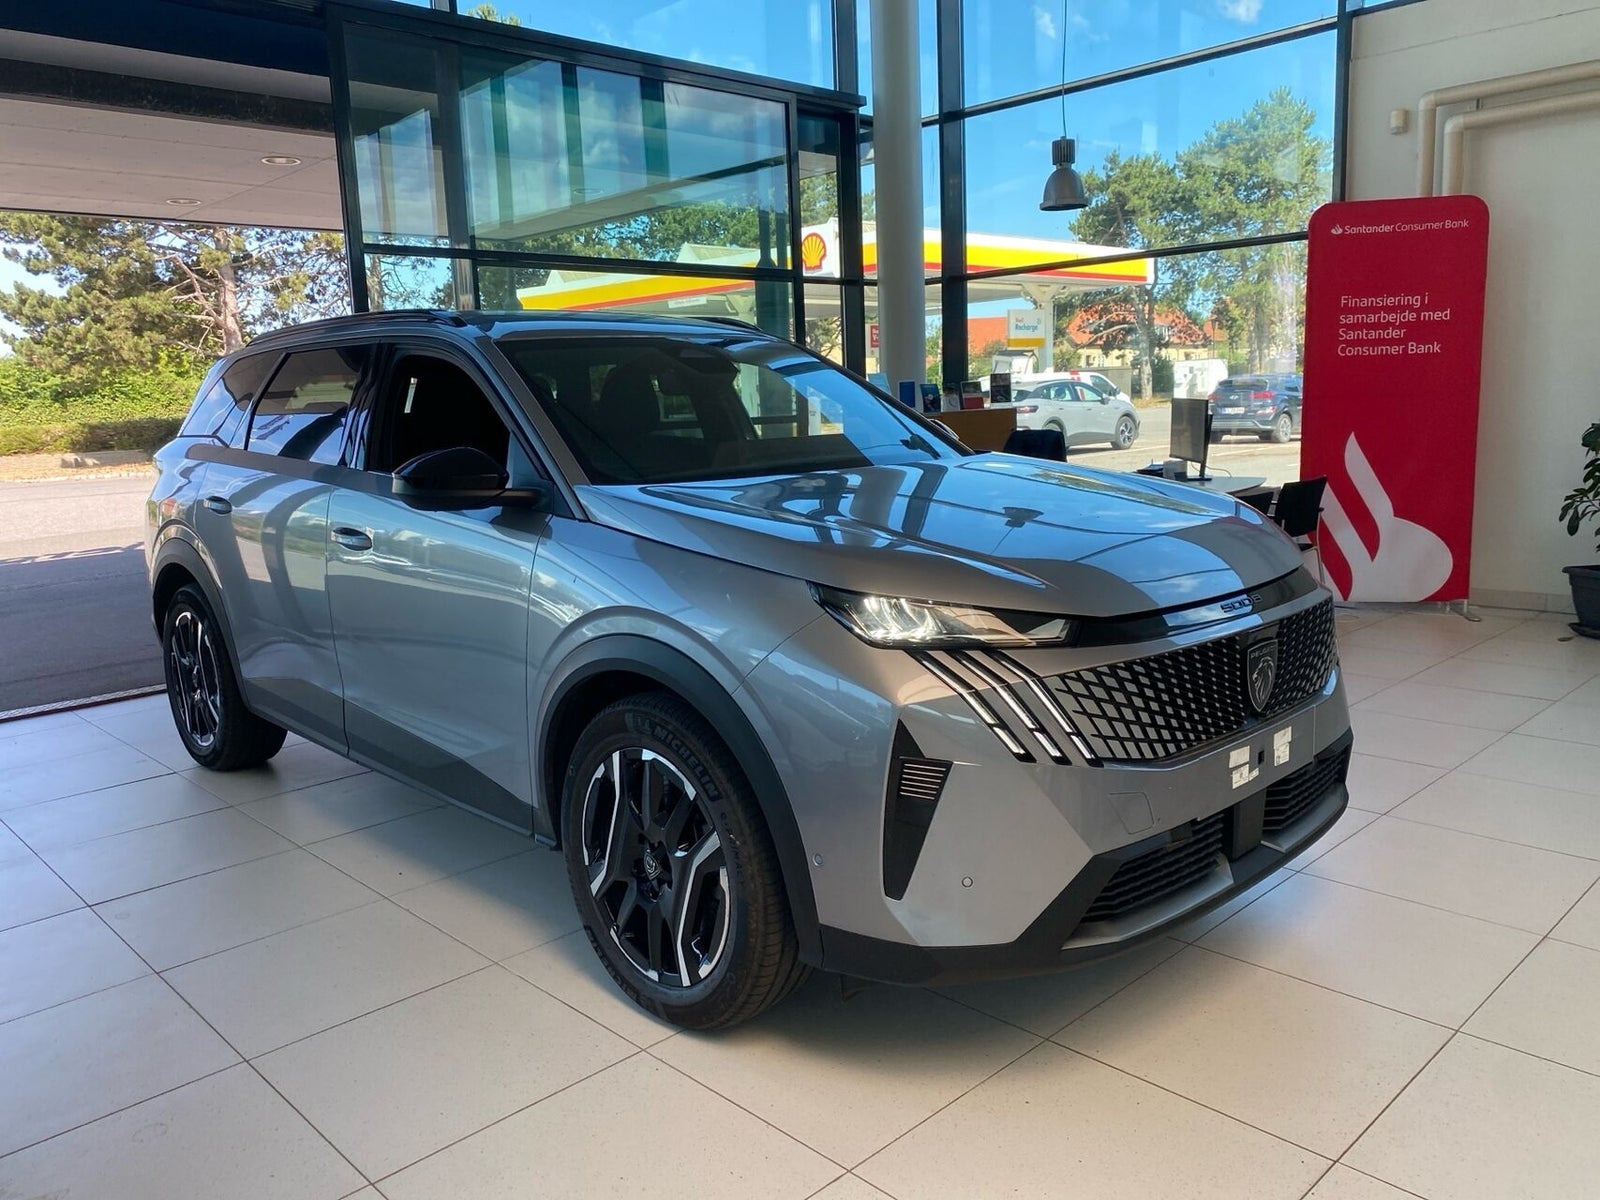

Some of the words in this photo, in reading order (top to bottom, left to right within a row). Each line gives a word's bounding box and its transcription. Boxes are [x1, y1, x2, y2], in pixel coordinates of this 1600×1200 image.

[1344, 224, 1395, 235] Santander
[1395, 221, 1444, 232] Consumer
[1444, 219, 1469, 229] Bank
[1341, 293, 1421, 308] Finansiering
[1424, 292, 1429, 304] i
[1339, 310, 1417, 325] samarbejde
[1420, 308, 1450, 321] med
[1338, 326, 1407, 340] Santander
[1337, 343, 1405, 356] Consumer
[1408, 341, 1441, 354] Bank
[652, 726, 720, 800] MICHELIN
